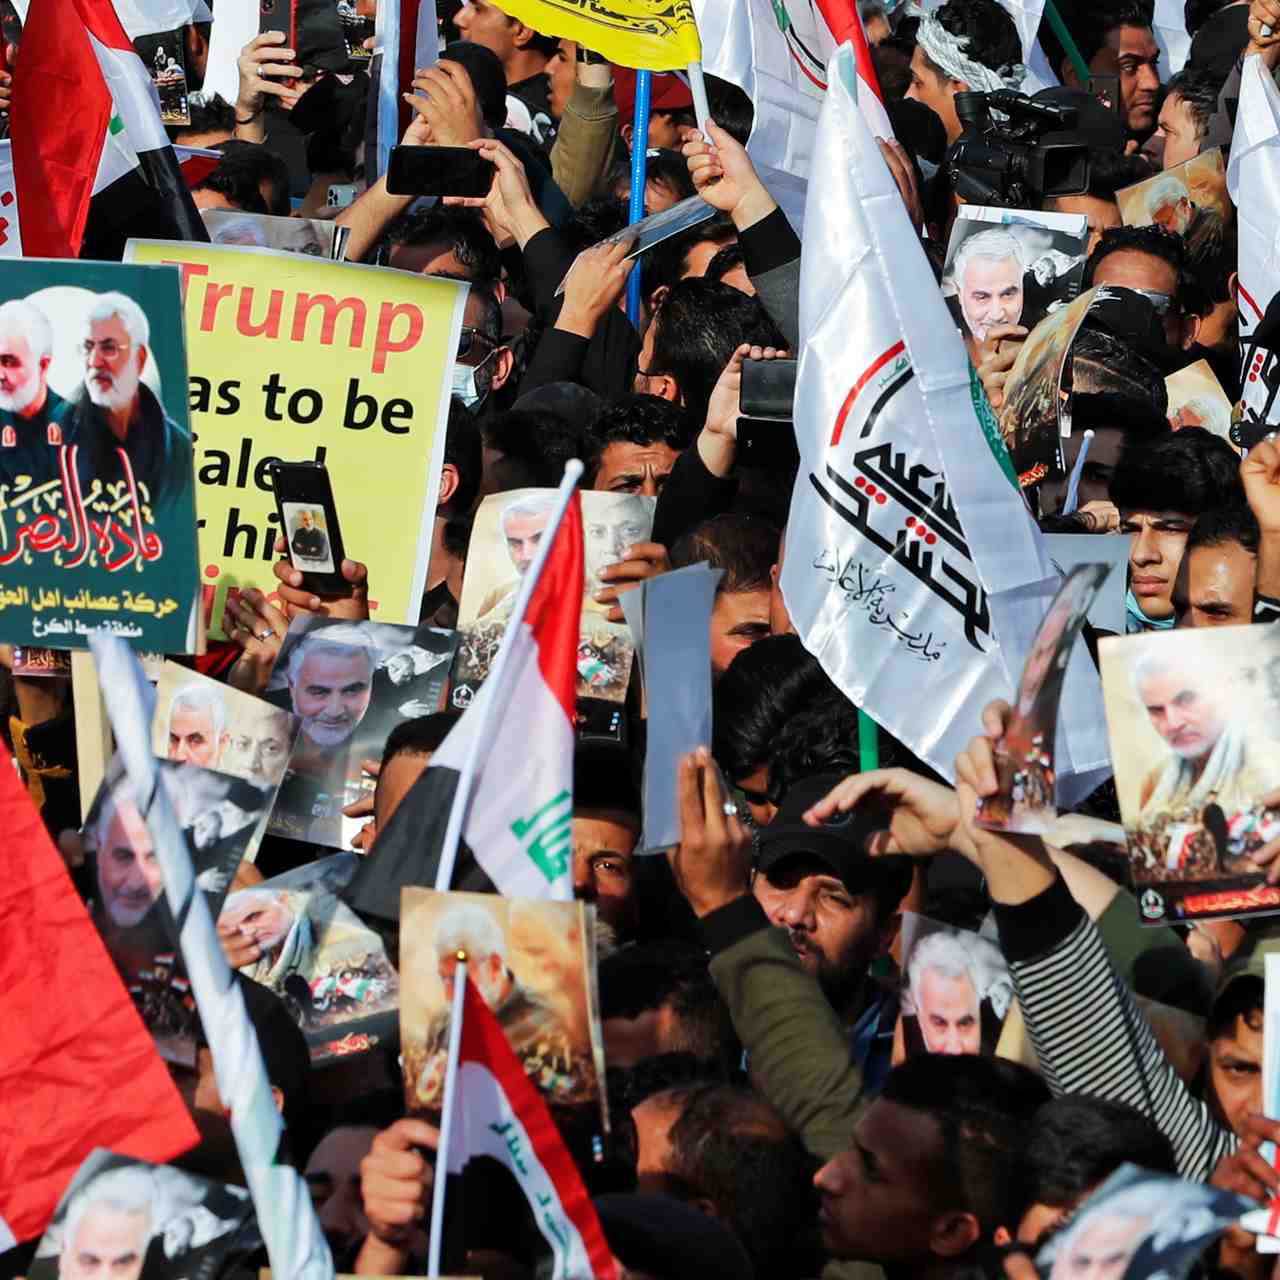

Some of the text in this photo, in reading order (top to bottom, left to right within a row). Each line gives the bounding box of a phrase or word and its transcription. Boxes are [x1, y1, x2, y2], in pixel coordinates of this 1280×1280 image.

[179, 261, 426, 373] Trump
[188, 375, 415, 435] as to be
[122, 588, 179, 620] حركة
